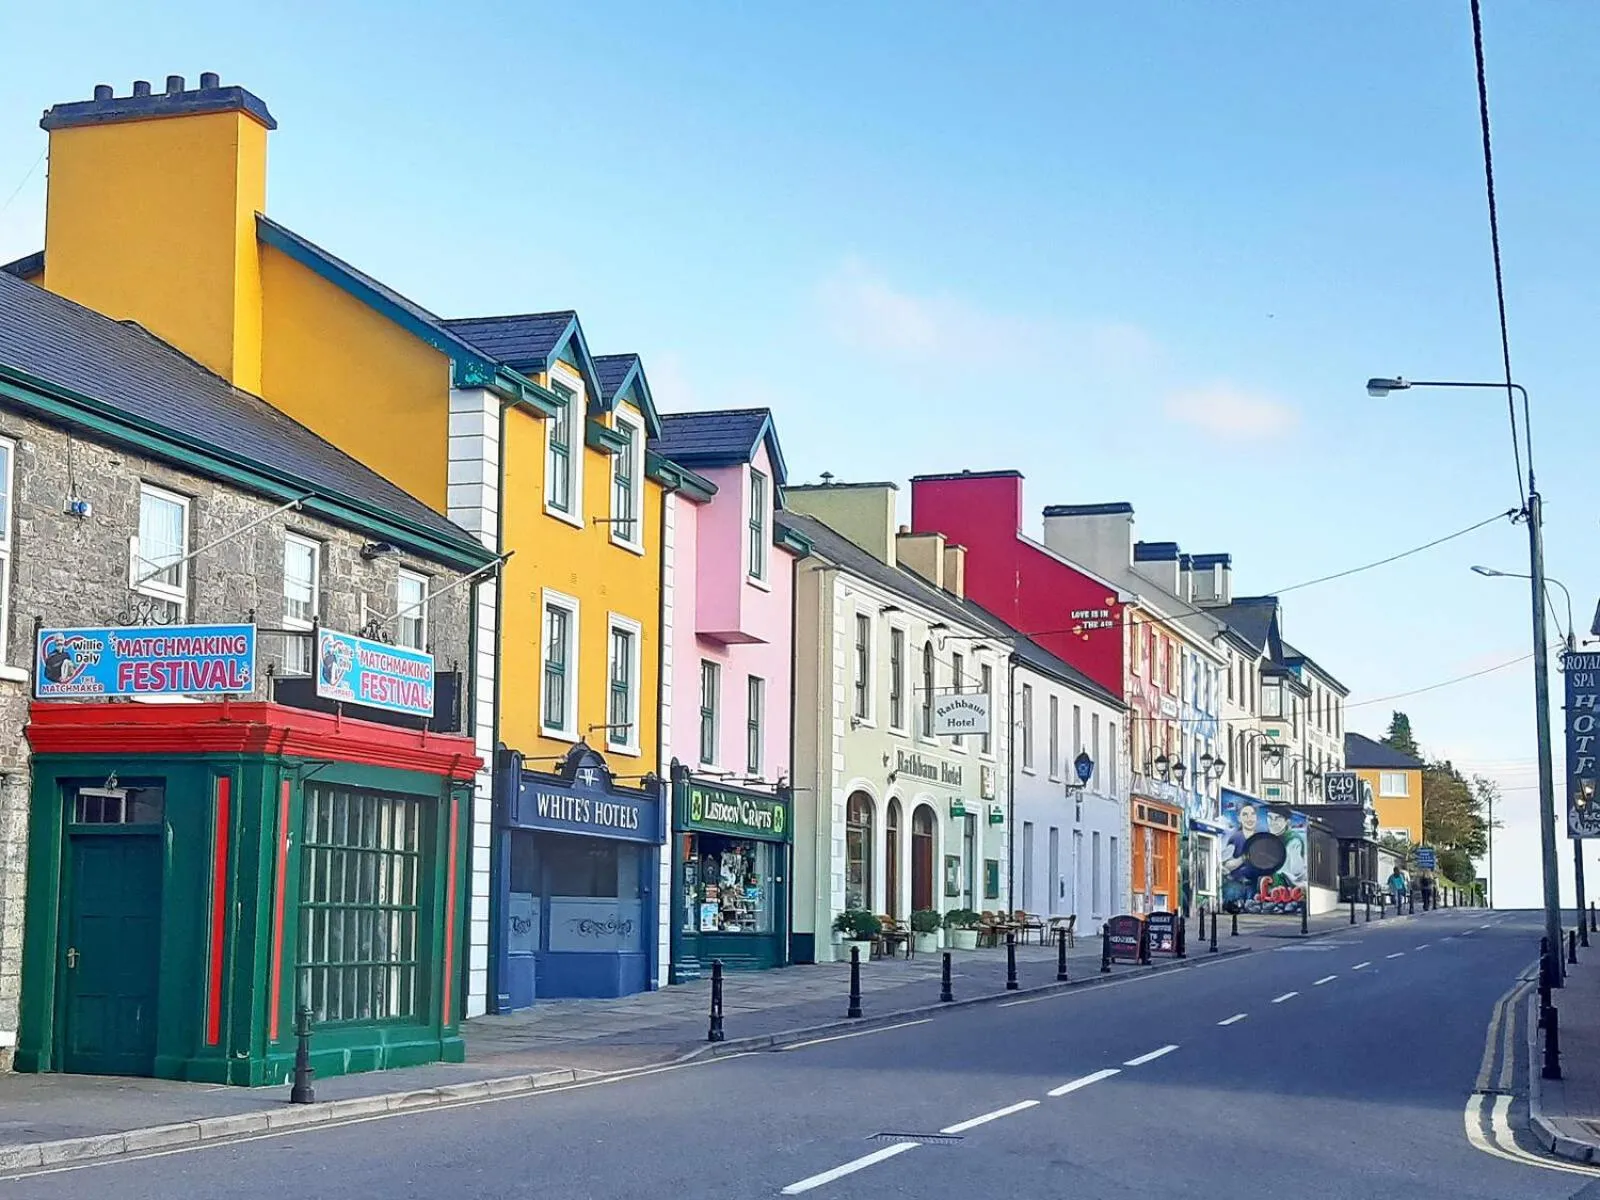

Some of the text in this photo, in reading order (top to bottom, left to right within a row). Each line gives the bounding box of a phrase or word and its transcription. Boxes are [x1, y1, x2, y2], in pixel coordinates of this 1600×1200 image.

[1071, 610, 1108, 619] LOVE IS IN
[1083, 621, 1098, 629] THE
[72, 638, 103, 651] Willie
[116, 636, 246, 657] MATCHMAKING
[76, 652, 99, 664] Daly
[360, 650, 430, 679] MATCHMAKING
[1566, 656, 1600, 670] ROYAL
[118, 661, 243, 690] FESTIVAL
[1573, 673, 1595, 687] SPA
[41, 684, 104, 693] MATCHMAKER
[361, 673, 428, 709] FESTIVAL
[937, 699, 986, 717] Rathbaun
[947, 718, 975, 727] Hotel
[897, 750, 938, 780] Rathbaun
[942, 761, 962, 786] Hotel
[1328, 777, 1354, 800] €49
[537, 793, 638, 830] WHITE'S HOTELS
[1254, 875, 1304, 902] Love
